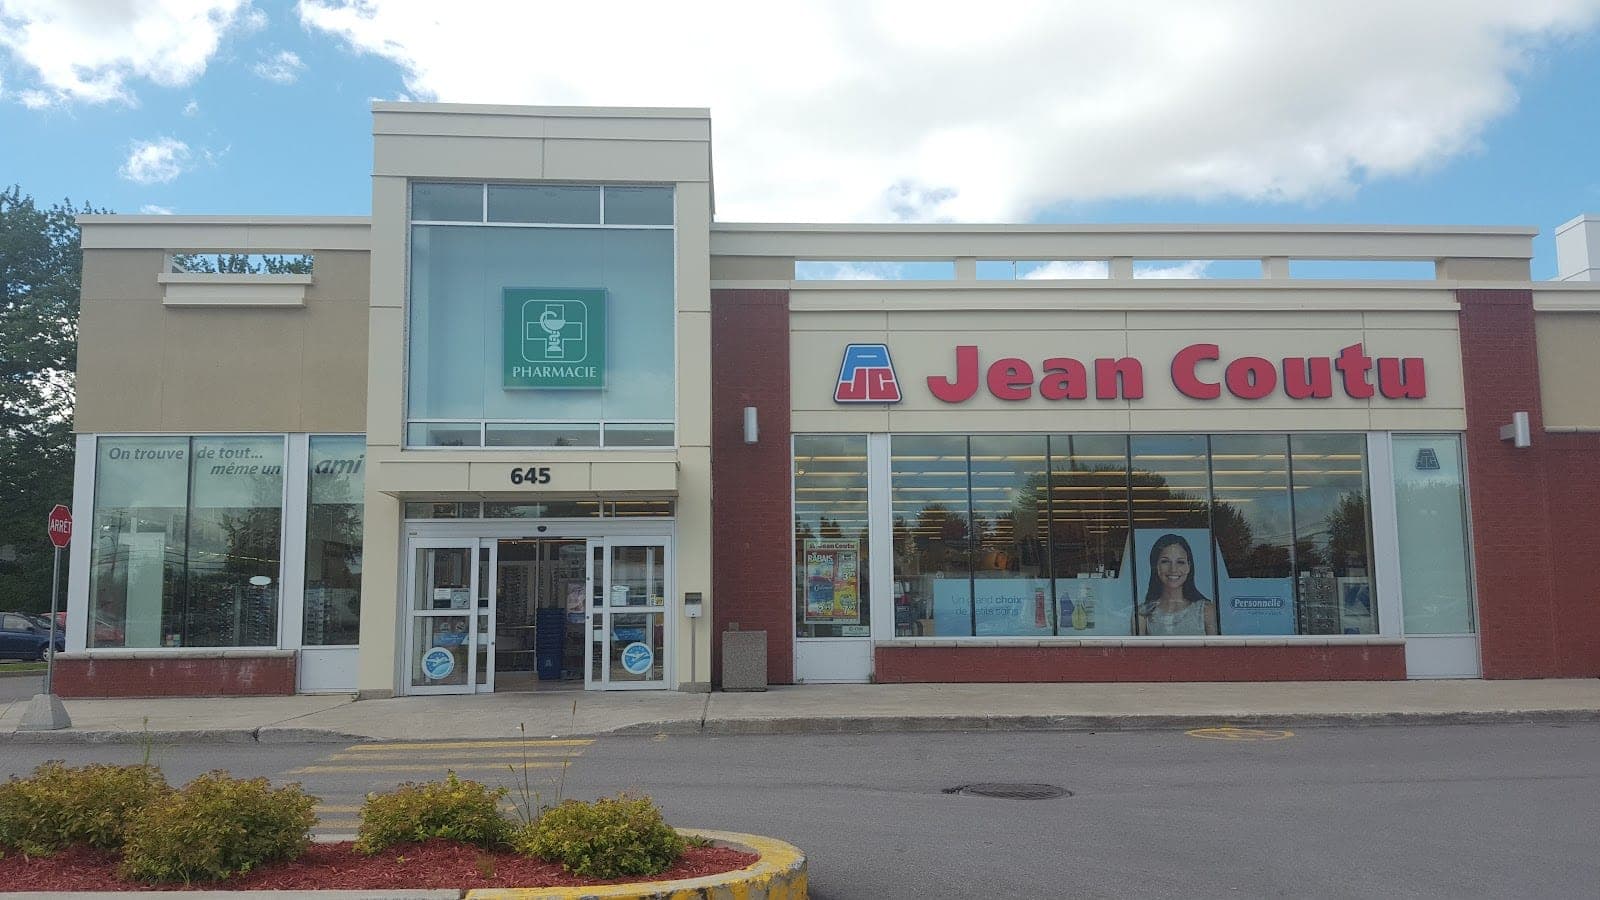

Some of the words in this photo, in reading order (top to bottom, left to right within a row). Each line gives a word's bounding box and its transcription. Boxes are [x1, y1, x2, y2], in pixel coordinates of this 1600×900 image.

[512, 366, 596, 378] PHARMACIE
[927, 345, 1144, 404] Jean
[1171, 342, 1427, 400] Coutu
[108, 447, 130, 460] On
[134, 448, 184, 460] trouve
[197, 447, 214, 459] de
[210, 463, 257, 475] même
[261, 465, 281, 476] un
[314, 454, 365, 476] ami
[510, 467, 551, 485] 645
[50, 518, 72, 534] ARRÊT
[995, 595, 1022, 604] choix
[1234, 598, 1281, 608] Personnelle
[955, 607, 968, 616] de
